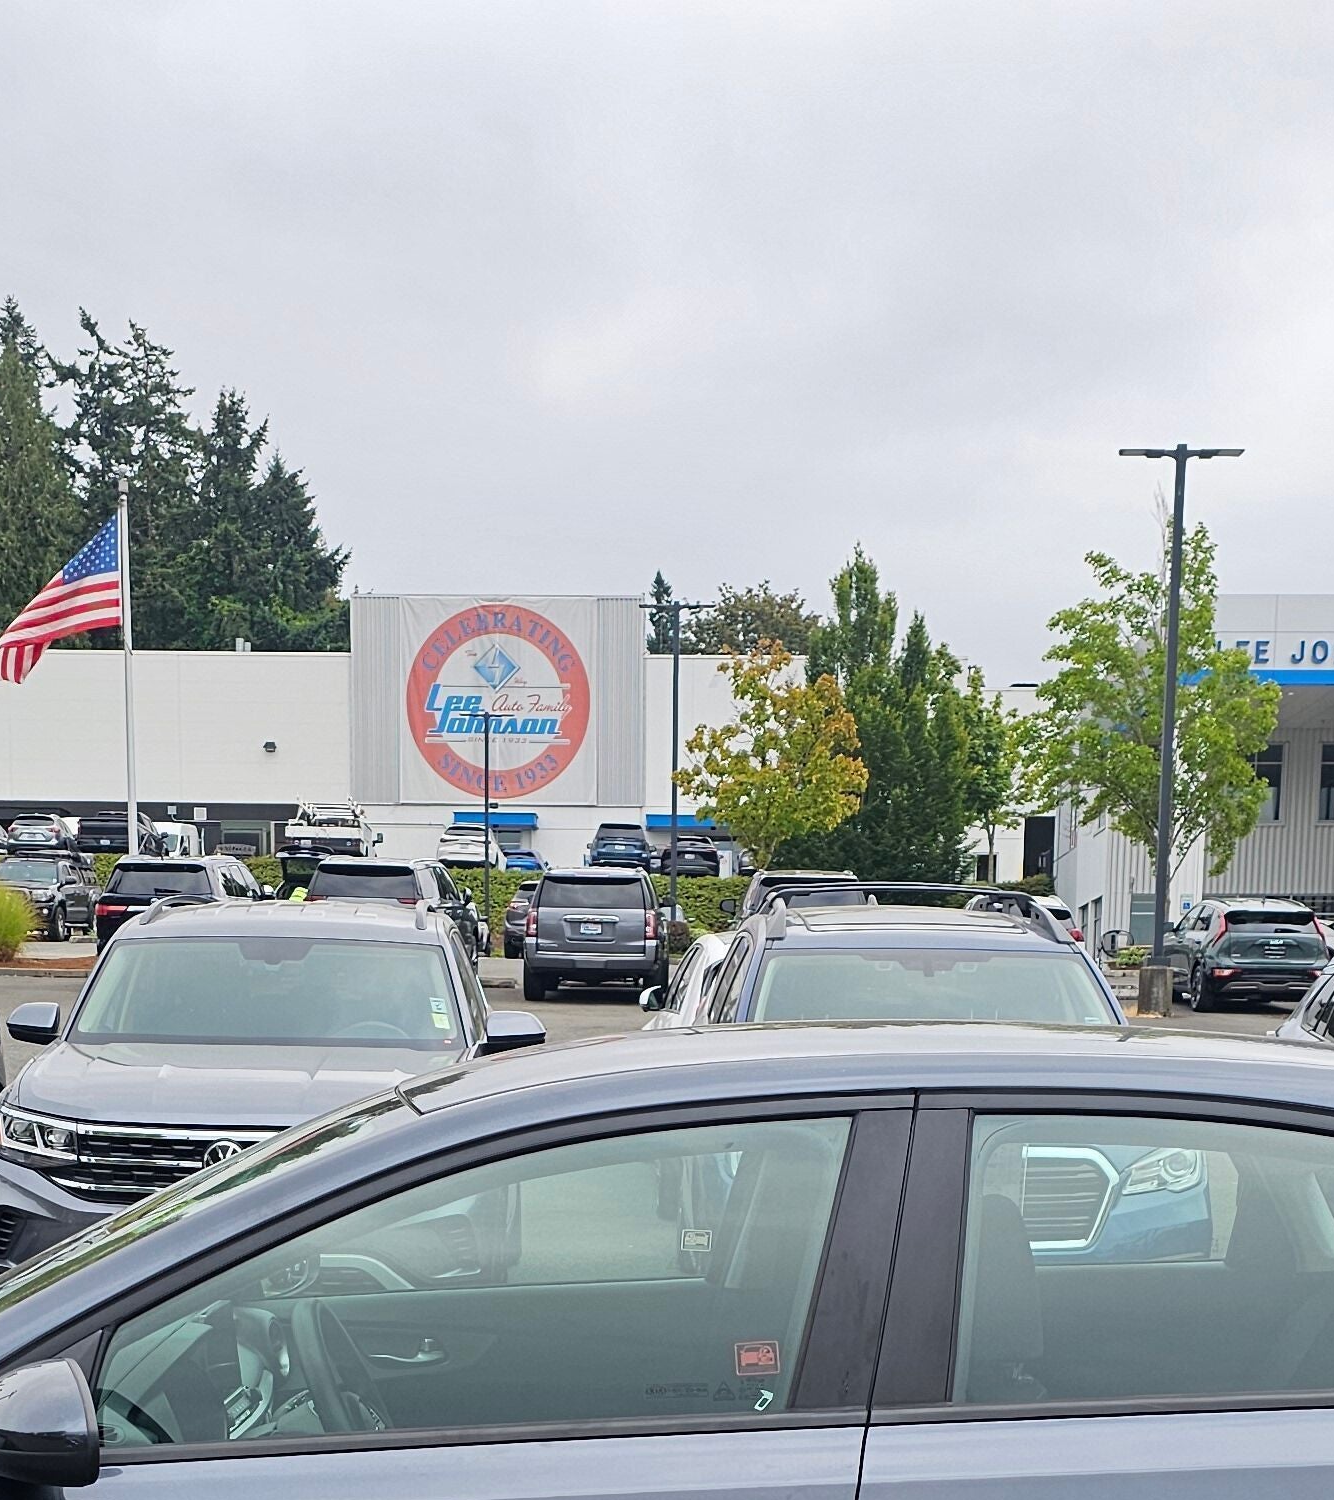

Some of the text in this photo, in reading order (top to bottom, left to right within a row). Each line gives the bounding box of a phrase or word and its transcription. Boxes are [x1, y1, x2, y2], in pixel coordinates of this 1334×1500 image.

[422, 611, 575, 672] CELEBRATING
[425, 682, 573, 719] Lee Auto Family
[438, 753, 560, 792] SINCE 1933
